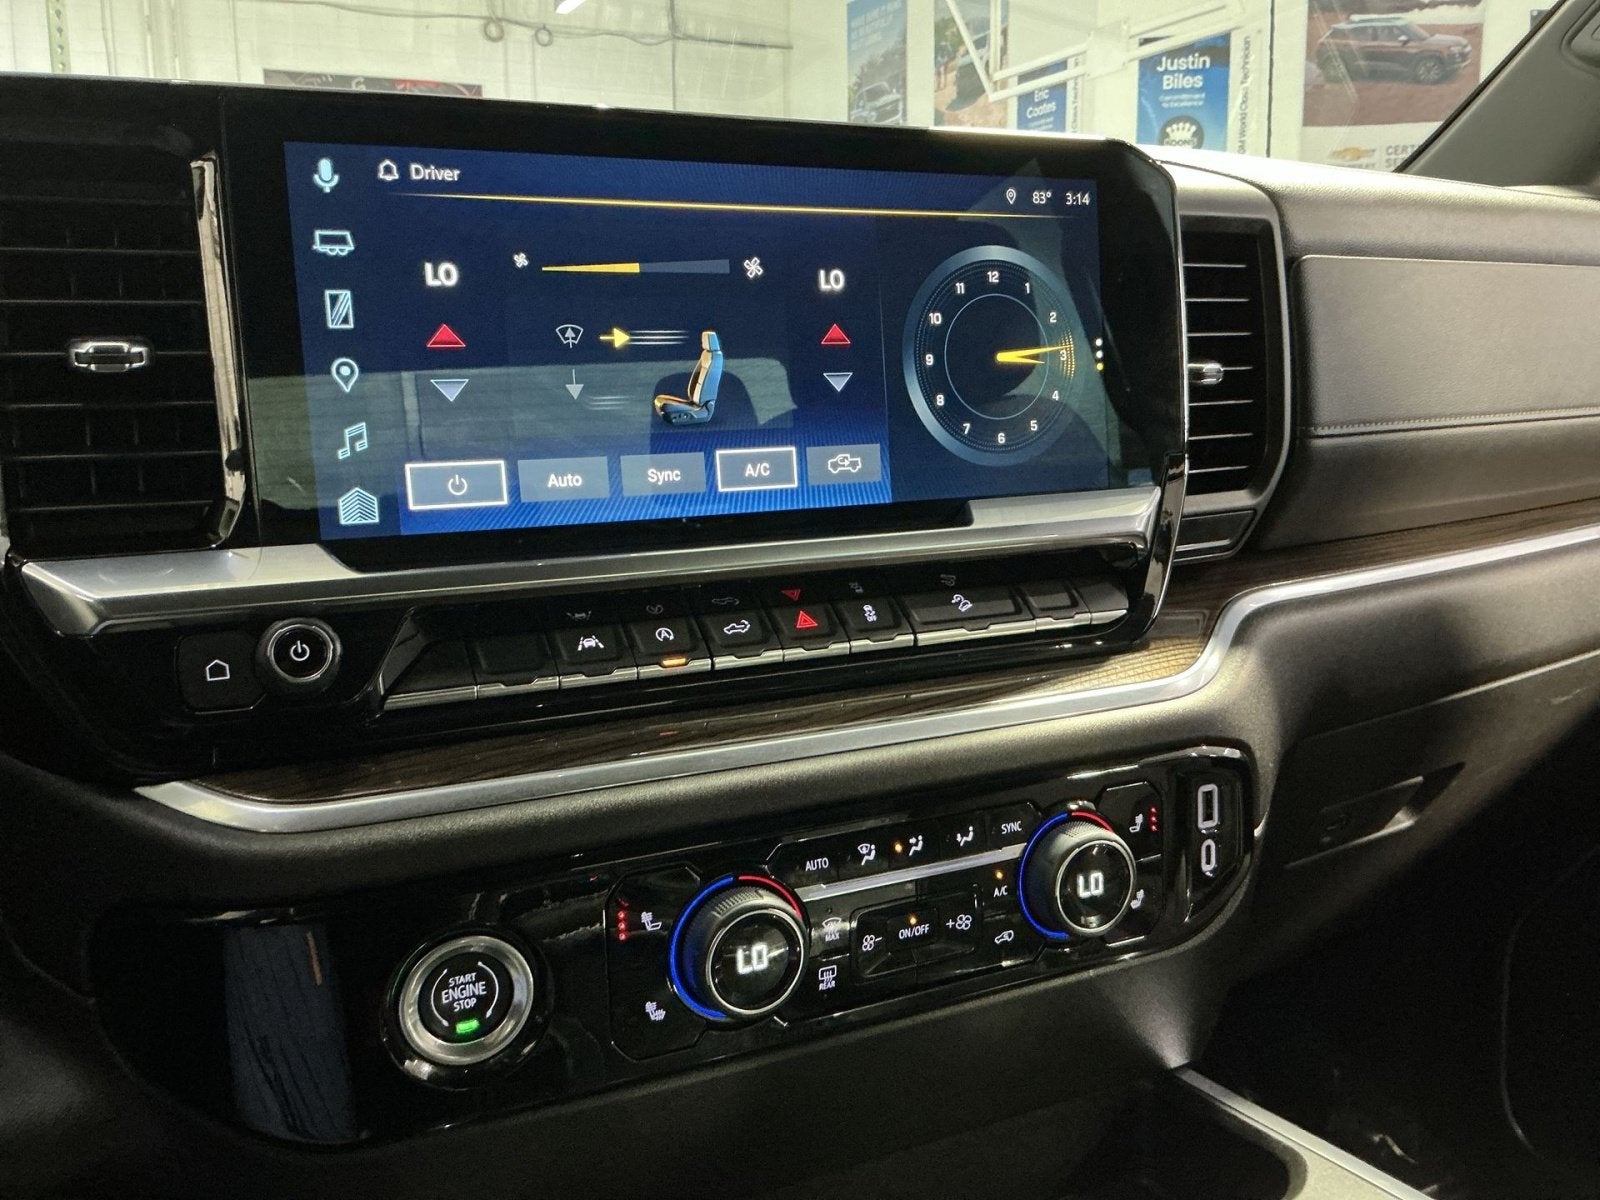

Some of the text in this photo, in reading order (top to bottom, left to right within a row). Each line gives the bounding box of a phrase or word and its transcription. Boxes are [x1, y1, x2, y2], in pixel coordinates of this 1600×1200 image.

[1156, 52, 1211, 72] Justin
[1162, 73, 1204, 90] Biles
[1026, 102, 1056, 118] Coates
[409, 163, 461, 182] Driver
[1065, 191, 1091, 207] 3:14
[424, 261, 459, 287] LO
[818, 267, 845, 291] LO
[987, 271, 1000, 284] 12
[955, 282, 966, 296] 11
[1024, 282, 1031, 294] 1
[928, 311, 943, 326] 10
[1049, 312, 1057, 324] 2
[925, 352, 934, 367] 9
[936, 394, 946, 407] 8
[1052, 389, 1060, 402] 4
[962, 422, 971, 436] 7
[1030, 419, 1039, 432] 5
[997, 431, 1006, 445] 6
[647, 468, 682, 486] Sync
[745, 463, 770, 478] A/C
[547, 472, 583, 488] Auto
[1001, 820, 1023, 835] SYNC
[805, 856, 830, 872] AUTO
[993, 885, 1008, 899] A/C
[1077, 870, 1105, 899] LO
[898, 923, 930, 941] ON/OFF
[736, 943, 769, 976] LO
[448, 972, 477, 987] START
[818, 978, 837, 991] REAR
[441, 981, 488, 1005] ENGINE
[453, 997, 478, 1013] STOP
